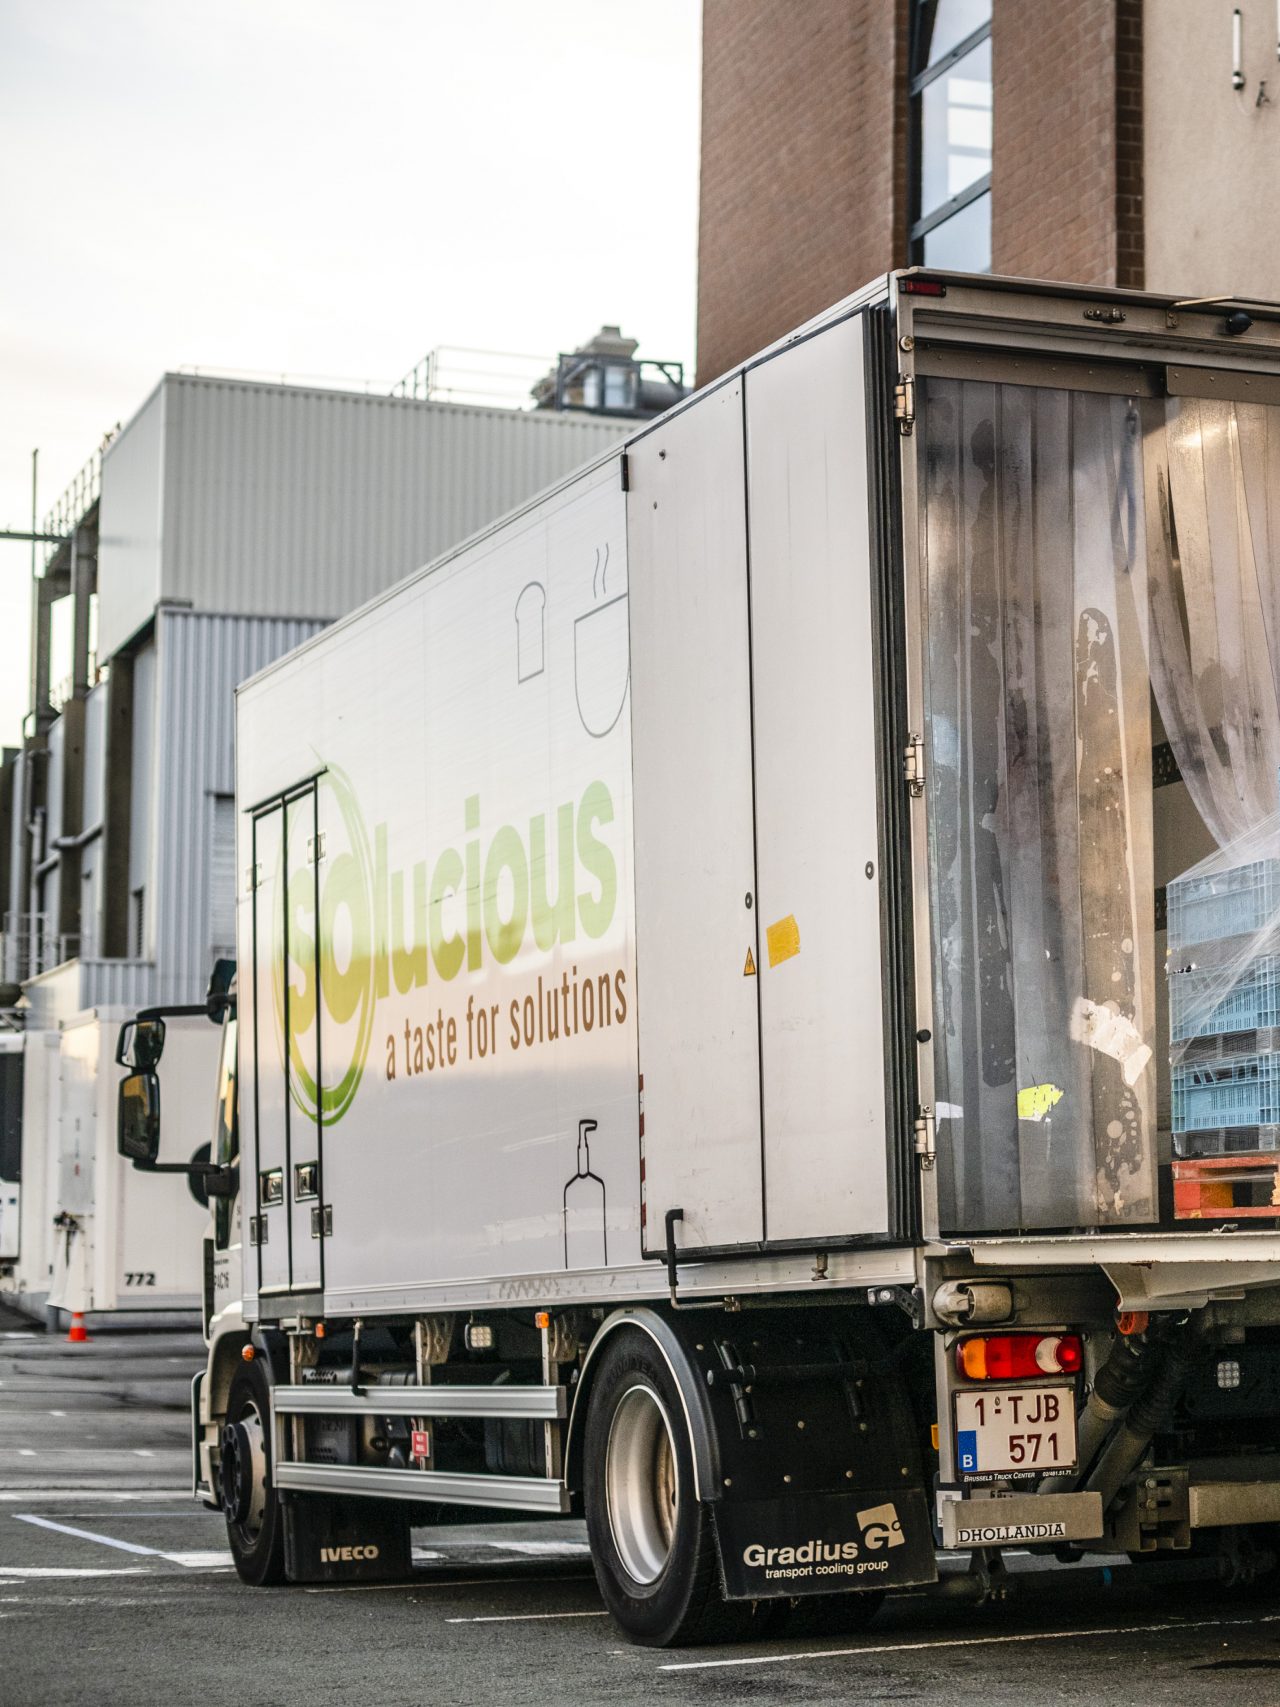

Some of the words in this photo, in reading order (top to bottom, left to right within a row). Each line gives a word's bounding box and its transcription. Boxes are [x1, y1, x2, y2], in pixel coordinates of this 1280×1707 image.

[288, 779, 618, 1035] solucious
[385, 1032, 396, 1081] a
[406, 1008, 457, 1078] taste
[466, 994, 499, 1060] for
[510, 965, 628, 1050] solutions
[124, 1272, 156, 1287] 772
[1009, 1432, 1060, 1463] 571
[962, 1454, 974, 1468] B
[963, 1474, 994, 1483] BRUSSELS
[994, 1473, 1013, 1481] TRUCK
[1013, 1472, 1036, 1480] CENTER
[958, 1523, 1065, 1544] DHOLLANDIA
[320, 1545, 380, 1563] IVECO
[743, 1539, 859, 1567] Gradius
[765, 1566, 813, 1580] transport
[815, 1563, 855, 1578] cooling
[857, 1560, 889, 1575] group
